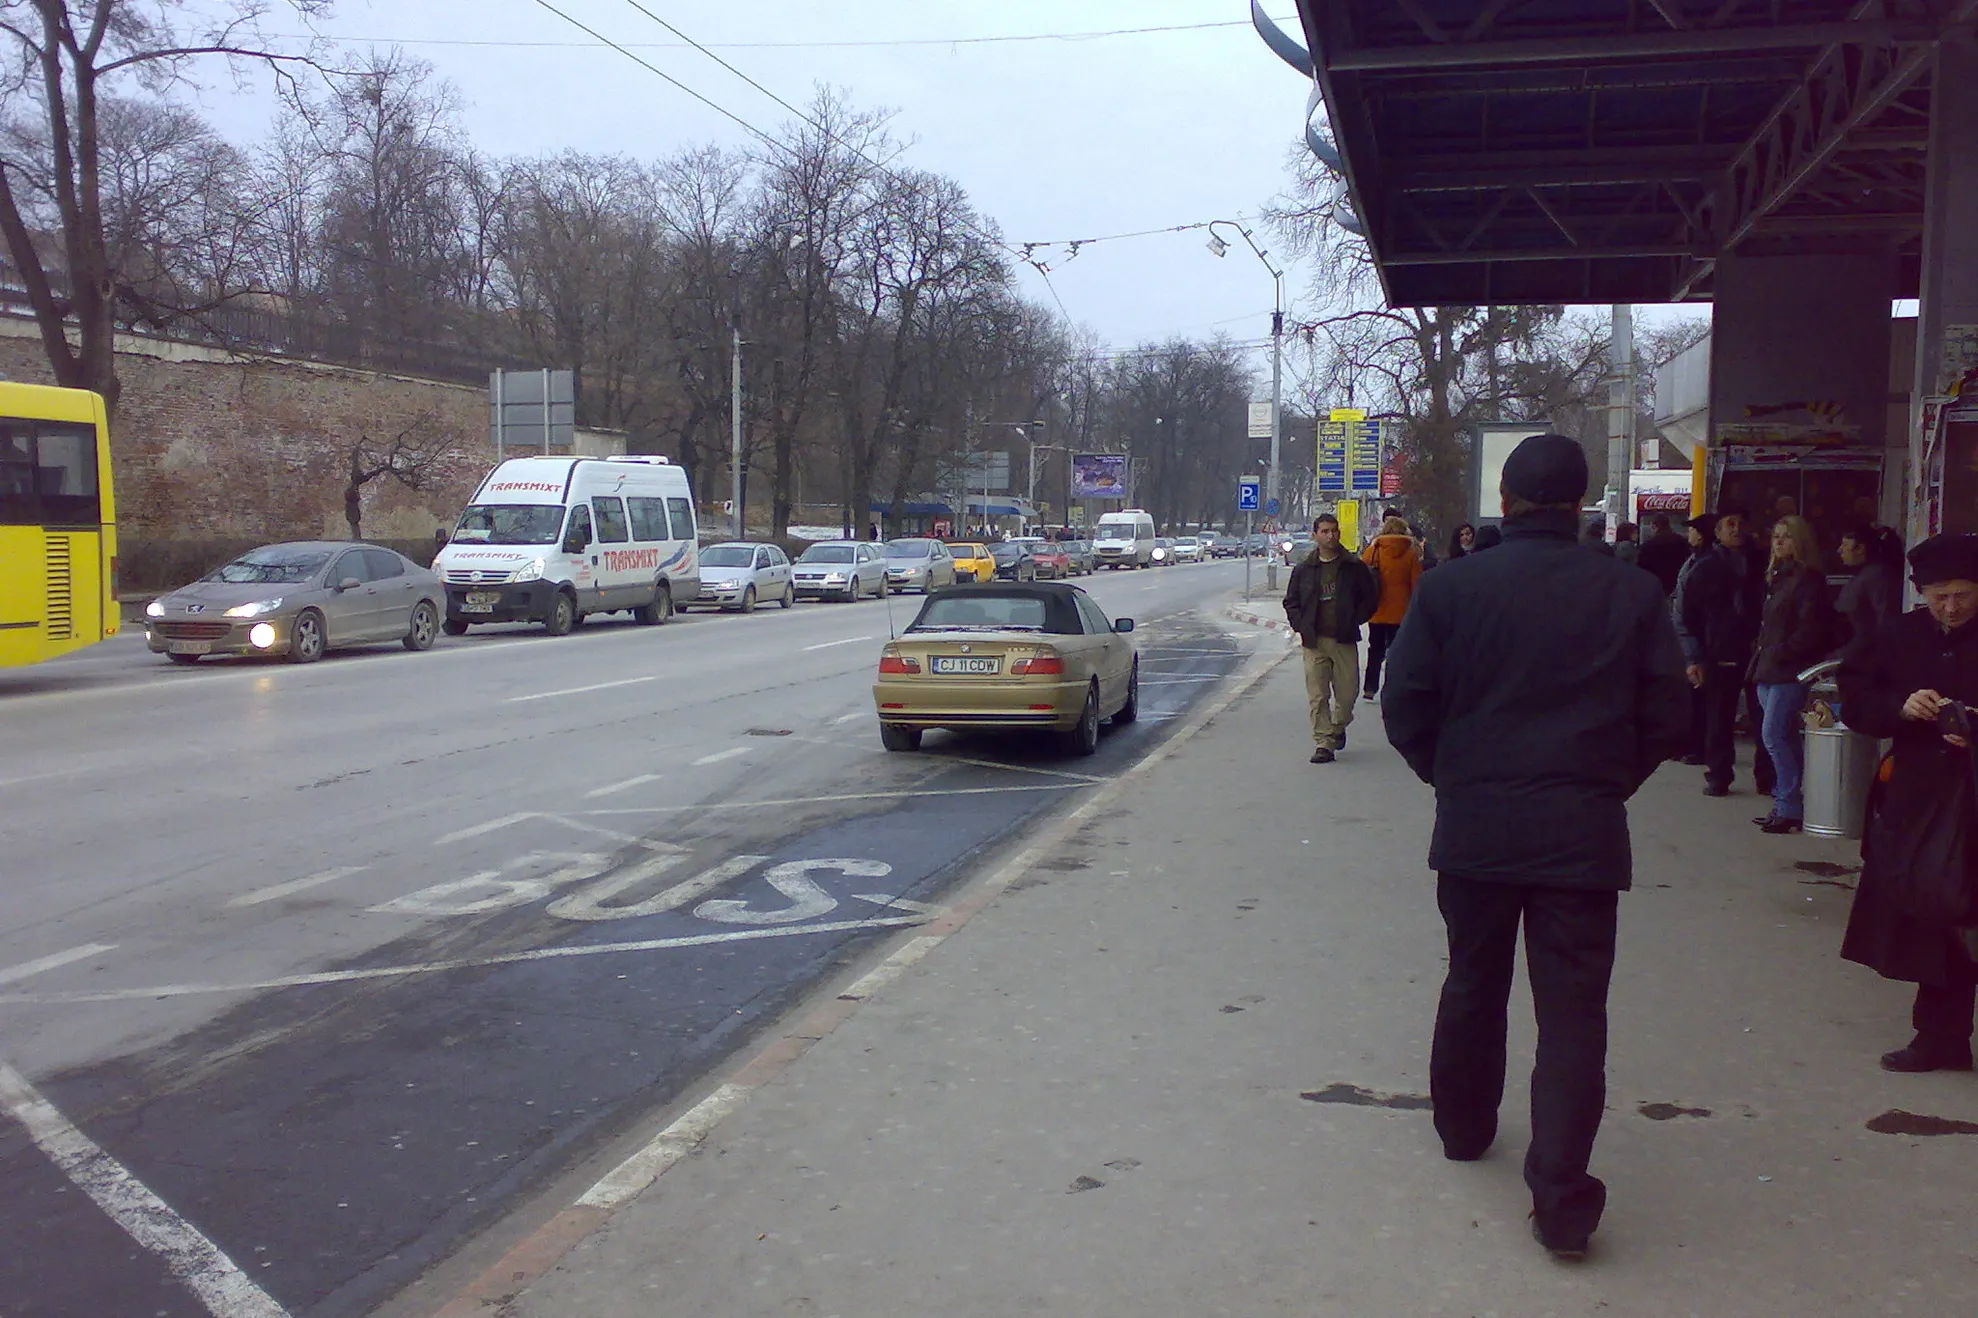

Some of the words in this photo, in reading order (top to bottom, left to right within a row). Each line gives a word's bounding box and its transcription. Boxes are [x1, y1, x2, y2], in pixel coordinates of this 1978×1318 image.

[490, 482, 562, 492] TRANSMIXT
[603, 548, 658, 572] TRANSMIXT
[941, 660, 955, 670] CJ
[970, 660, 995, 671] CDW
[364, 850, 892, 924] BUS
